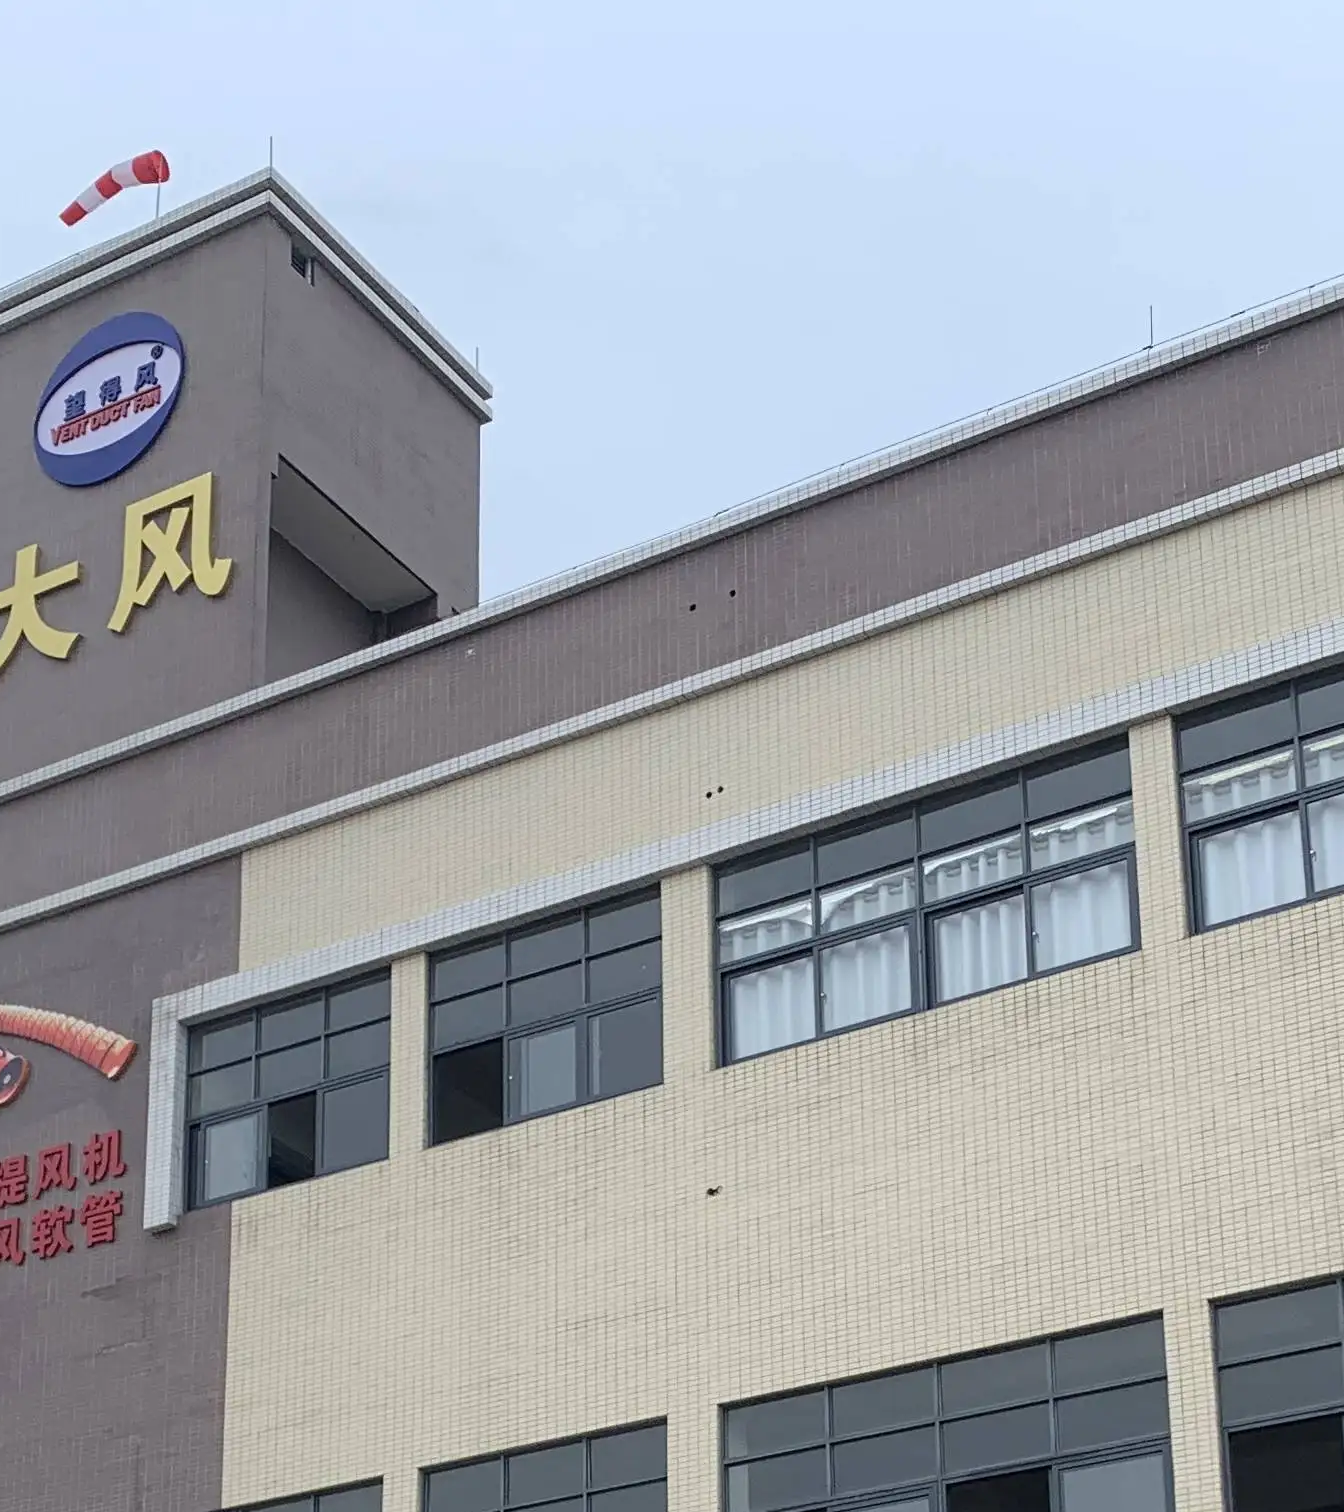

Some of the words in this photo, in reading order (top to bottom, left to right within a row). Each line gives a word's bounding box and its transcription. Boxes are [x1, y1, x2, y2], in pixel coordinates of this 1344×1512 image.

[50, 418, 90, 447] VENT
[90, 401, 132, 431] DUCT
[132, 387, 162, 414] FAN
